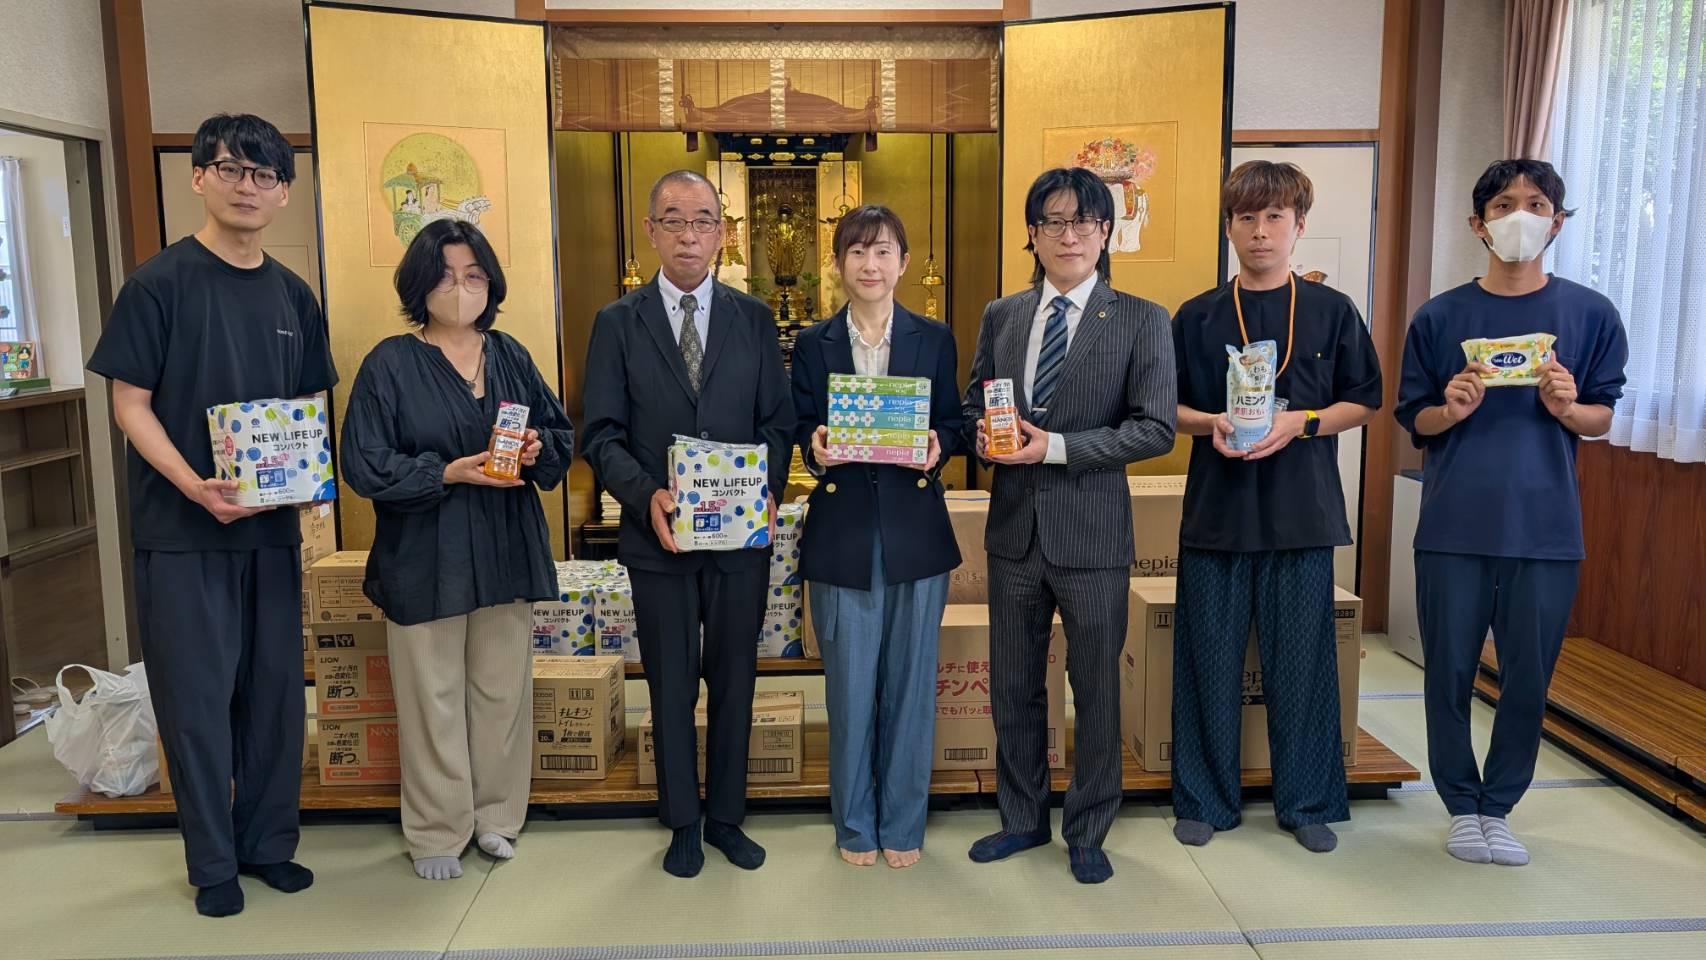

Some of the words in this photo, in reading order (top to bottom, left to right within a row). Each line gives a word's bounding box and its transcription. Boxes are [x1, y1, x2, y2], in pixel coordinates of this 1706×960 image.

[1236, 395, 1266, 406] ハミング
[252, 433, 279, 444] NEW
[284, 429, 323, 441] LIFEUP
[273, 442, 308, 451] コンパクト
[693, 479, 720, 489] NEW
[724, 477, 762, 488] LIFEUP
[712, 489, 746, 497] コンパクト
[773, 533, 798, 541] IFEUP
[553, 609, 584, 617] LIFEUP
[600, 609, 621, 617] NEW
